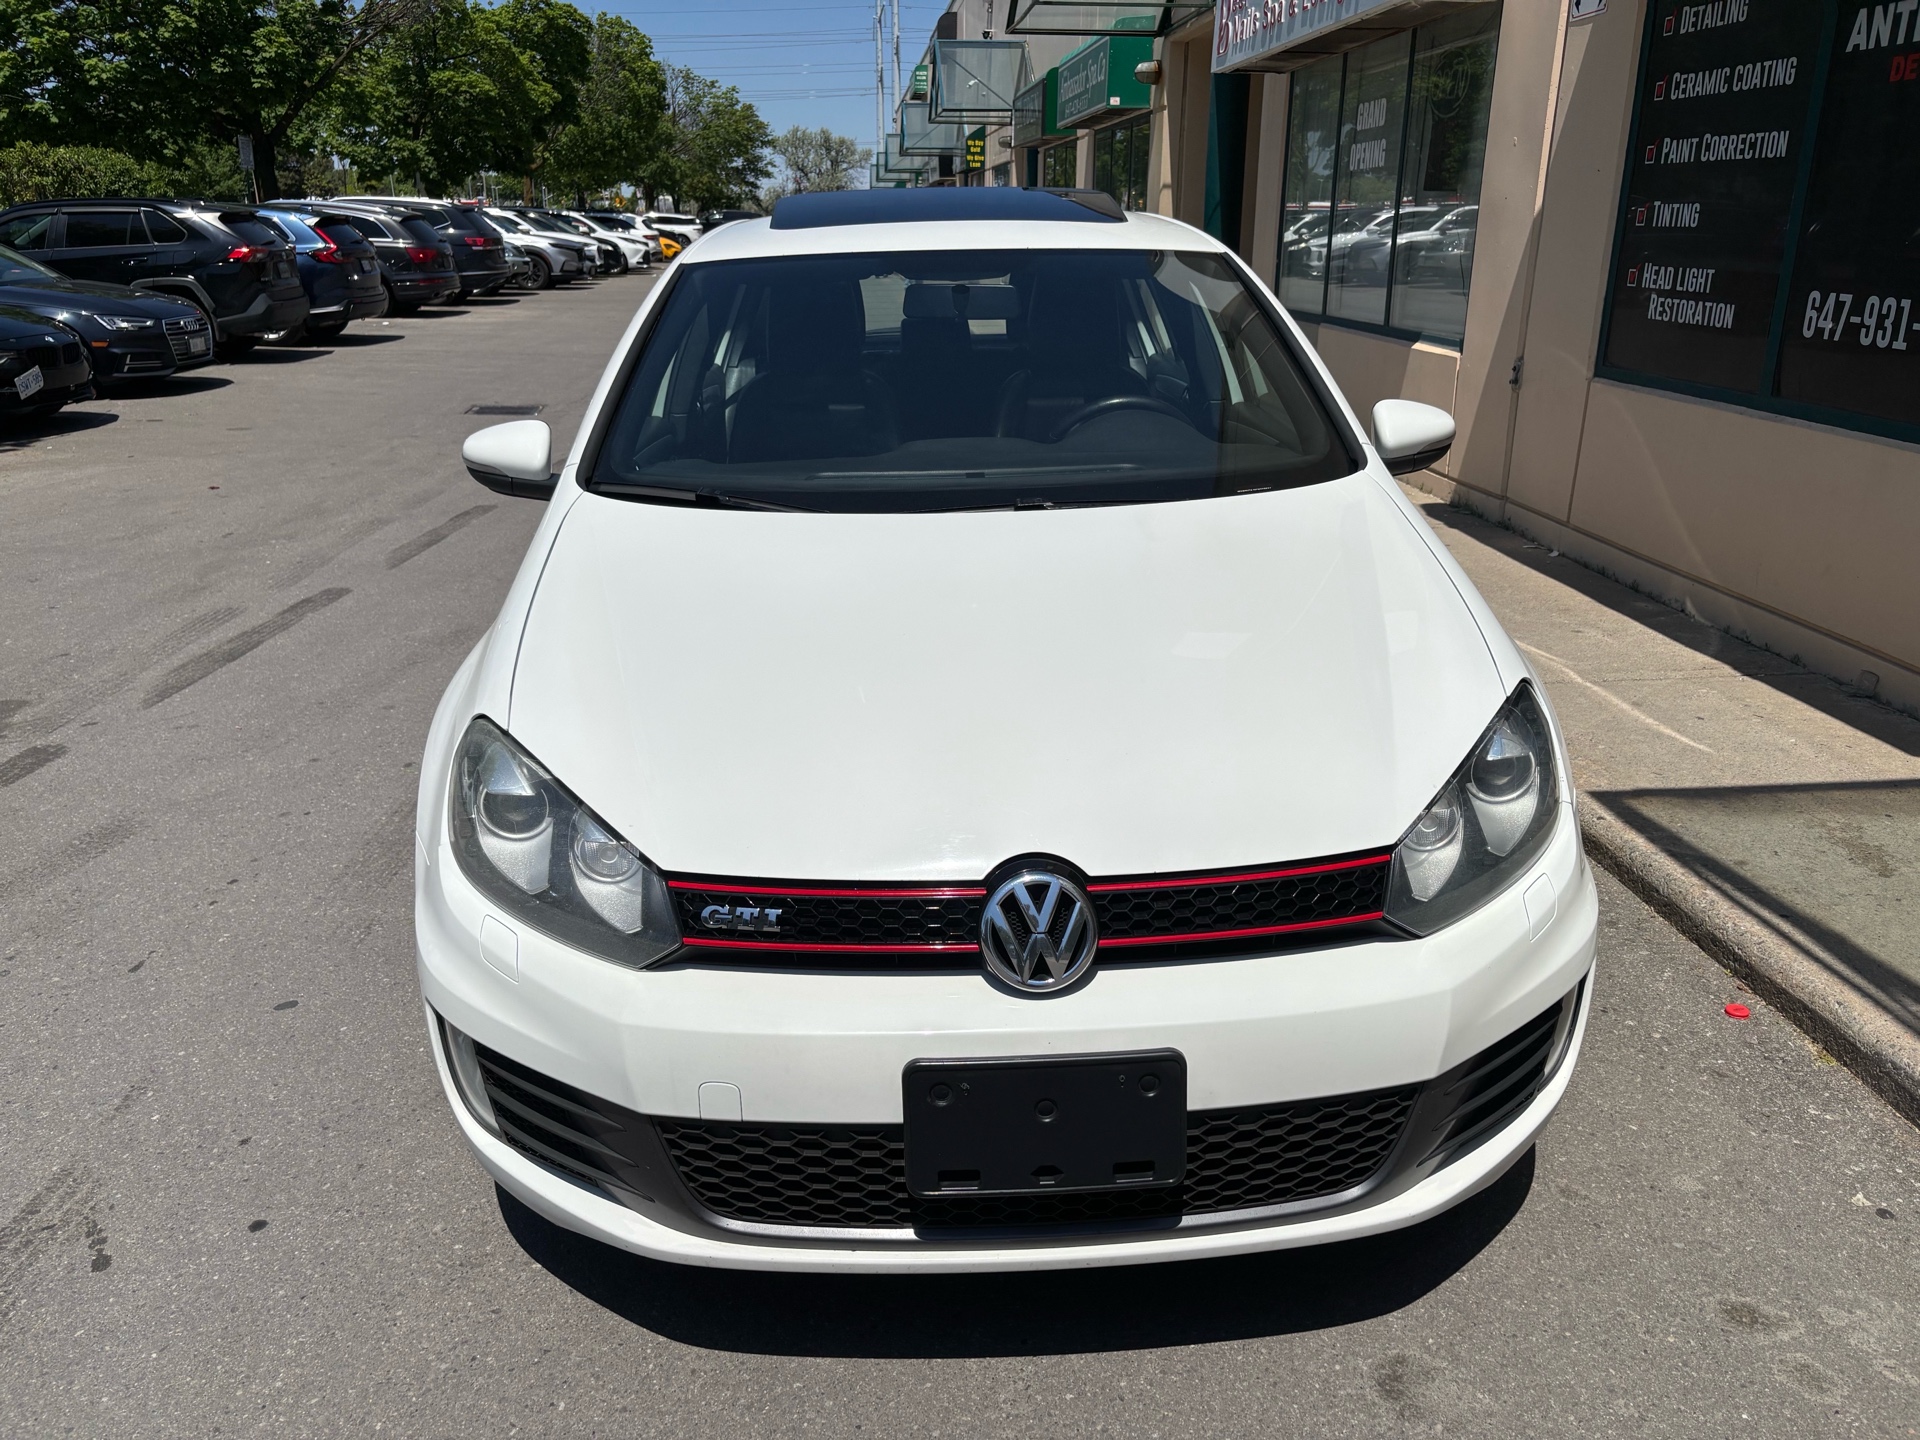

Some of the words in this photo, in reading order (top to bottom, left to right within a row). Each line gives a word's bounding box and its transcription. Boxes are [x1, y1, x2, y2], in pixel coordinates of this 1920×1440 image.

[1232, 6, 1260, 43] Nails
[1262, 0, 1285, 35] Spa
[1680, 0, 1749, 34] DETAILING
[1670, 67, 1731, 100] CERAMIC
[1732, 56, 1798, 92] COATING
[1357, 97, 1387, 131] GRAND
[1349, 138, 1387, 171] OPENING
[1660, 137, 1700, 164] PAINT
[1700, 130, 1790, 162] CORRECTION
[1652, 200, 1701, 228] TINTING
[1641, 262, 1675, 290] HEAD
[1676, 267, 1715, 294] LIGHT
[1647, 293, 1736, 329] RESTORATION
[701, 904, 782, 932] GTI
